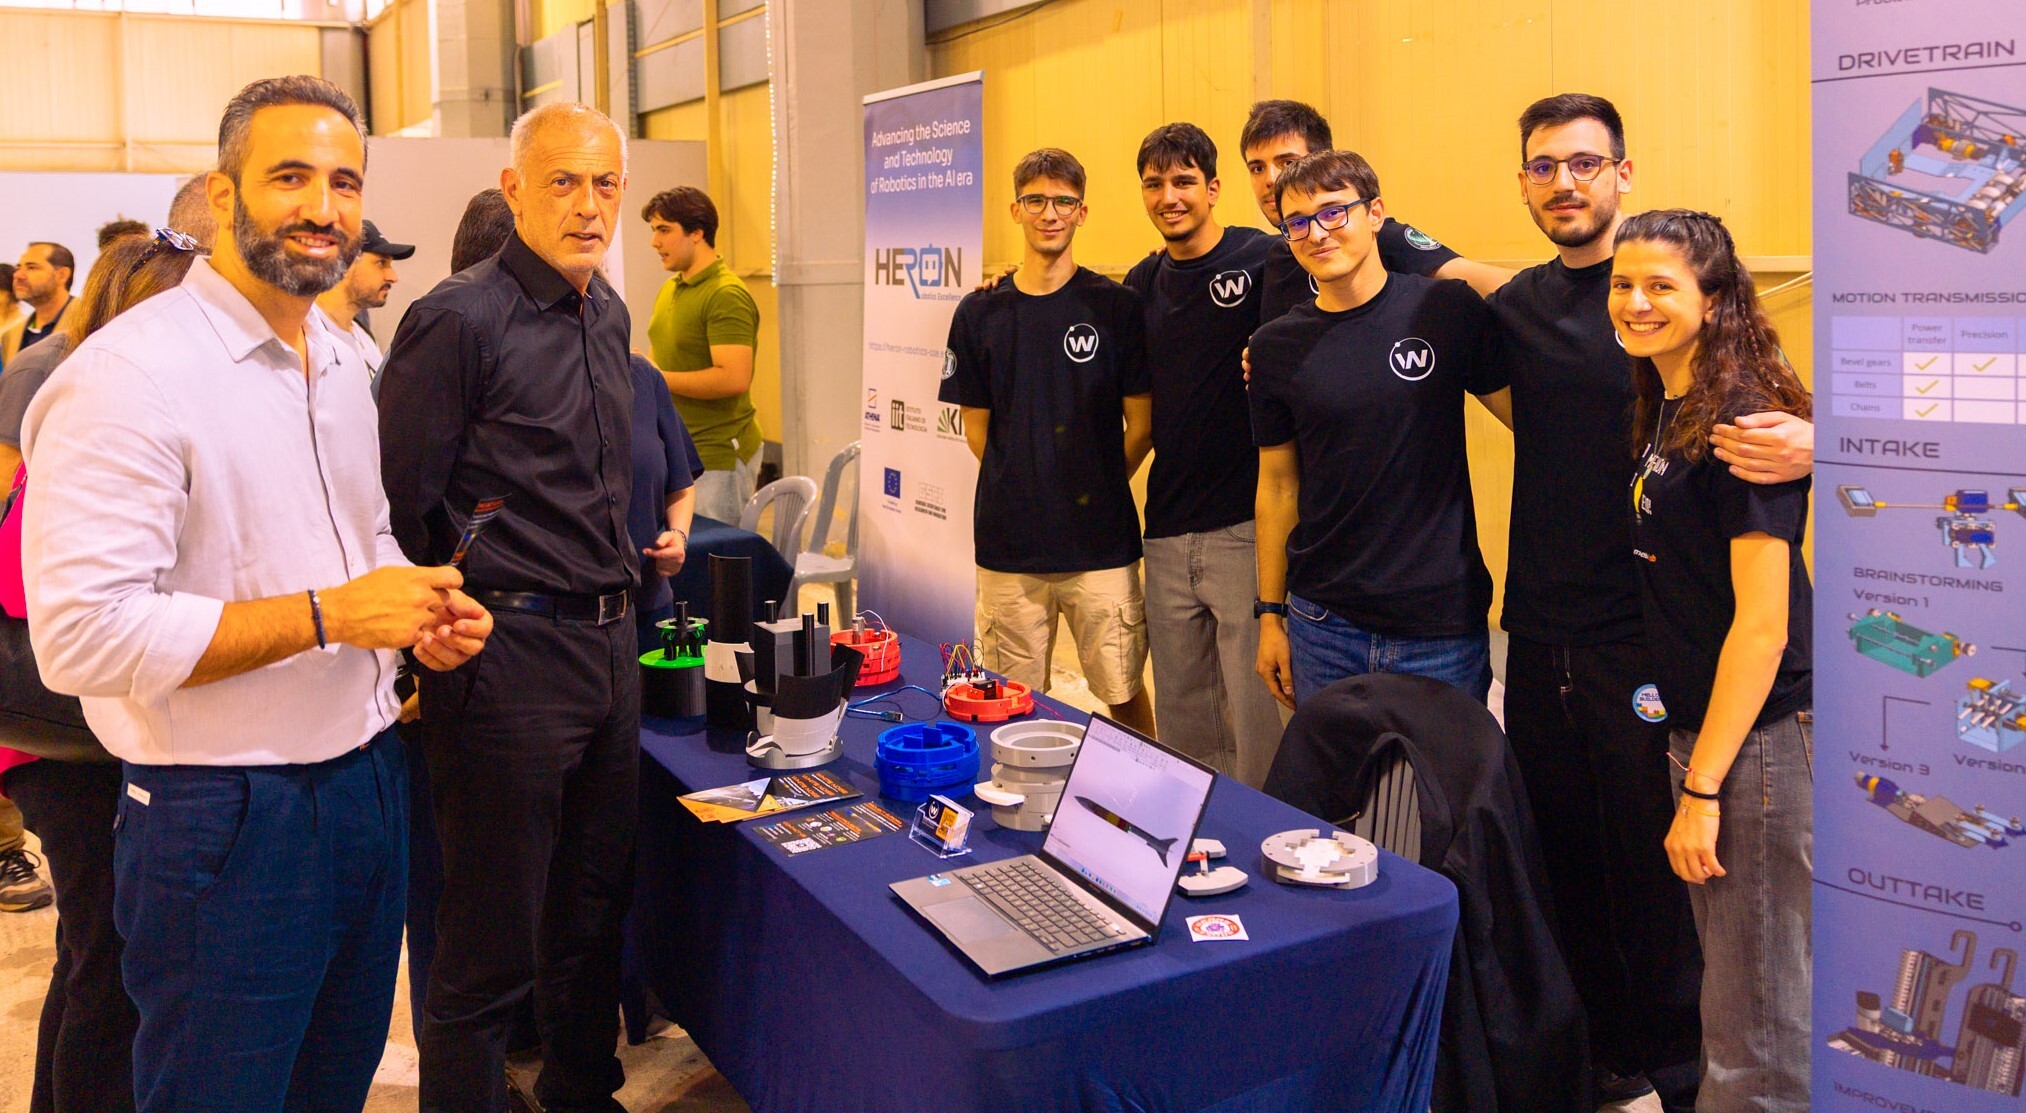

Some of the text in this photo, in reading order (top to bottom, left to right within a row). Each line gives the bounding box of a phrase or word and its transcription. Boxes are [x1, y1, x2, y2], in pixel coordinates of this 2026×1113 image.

[1838, 39, 2015, 71] DRIVETRAIN
[872, 119, 971, 147] Advancing the Science
[884, 147, 953, 169] and Technology
[870, 170, 973, 194] of Robotics in the AI era
[875, 244, 962, 299] HERON
[1832, 292, 2026, 303] MOTION TRANSMISSIO
[1912, 323, 1942, 332] Power
[1961, 330, 2008, 339] Precision
[1907, 336, 1946, 345] transfer
[1840, 358, 1892, 368] Bevel gears
[1854, 380, 1876, 389] Belts
[1850, 403, 1880, 412] Chains
[1840, 437, 1940, 458] INTAKE
[1853, 567, 2003, 592] BRAINSTORMING
[1853, 588, 1930, 608] Version 1
[1849, 751, 1931, 776] Version 3
[1953, 754, 2026, 774] Version
[1848, 867, 1985, 911] OUTTAKE
